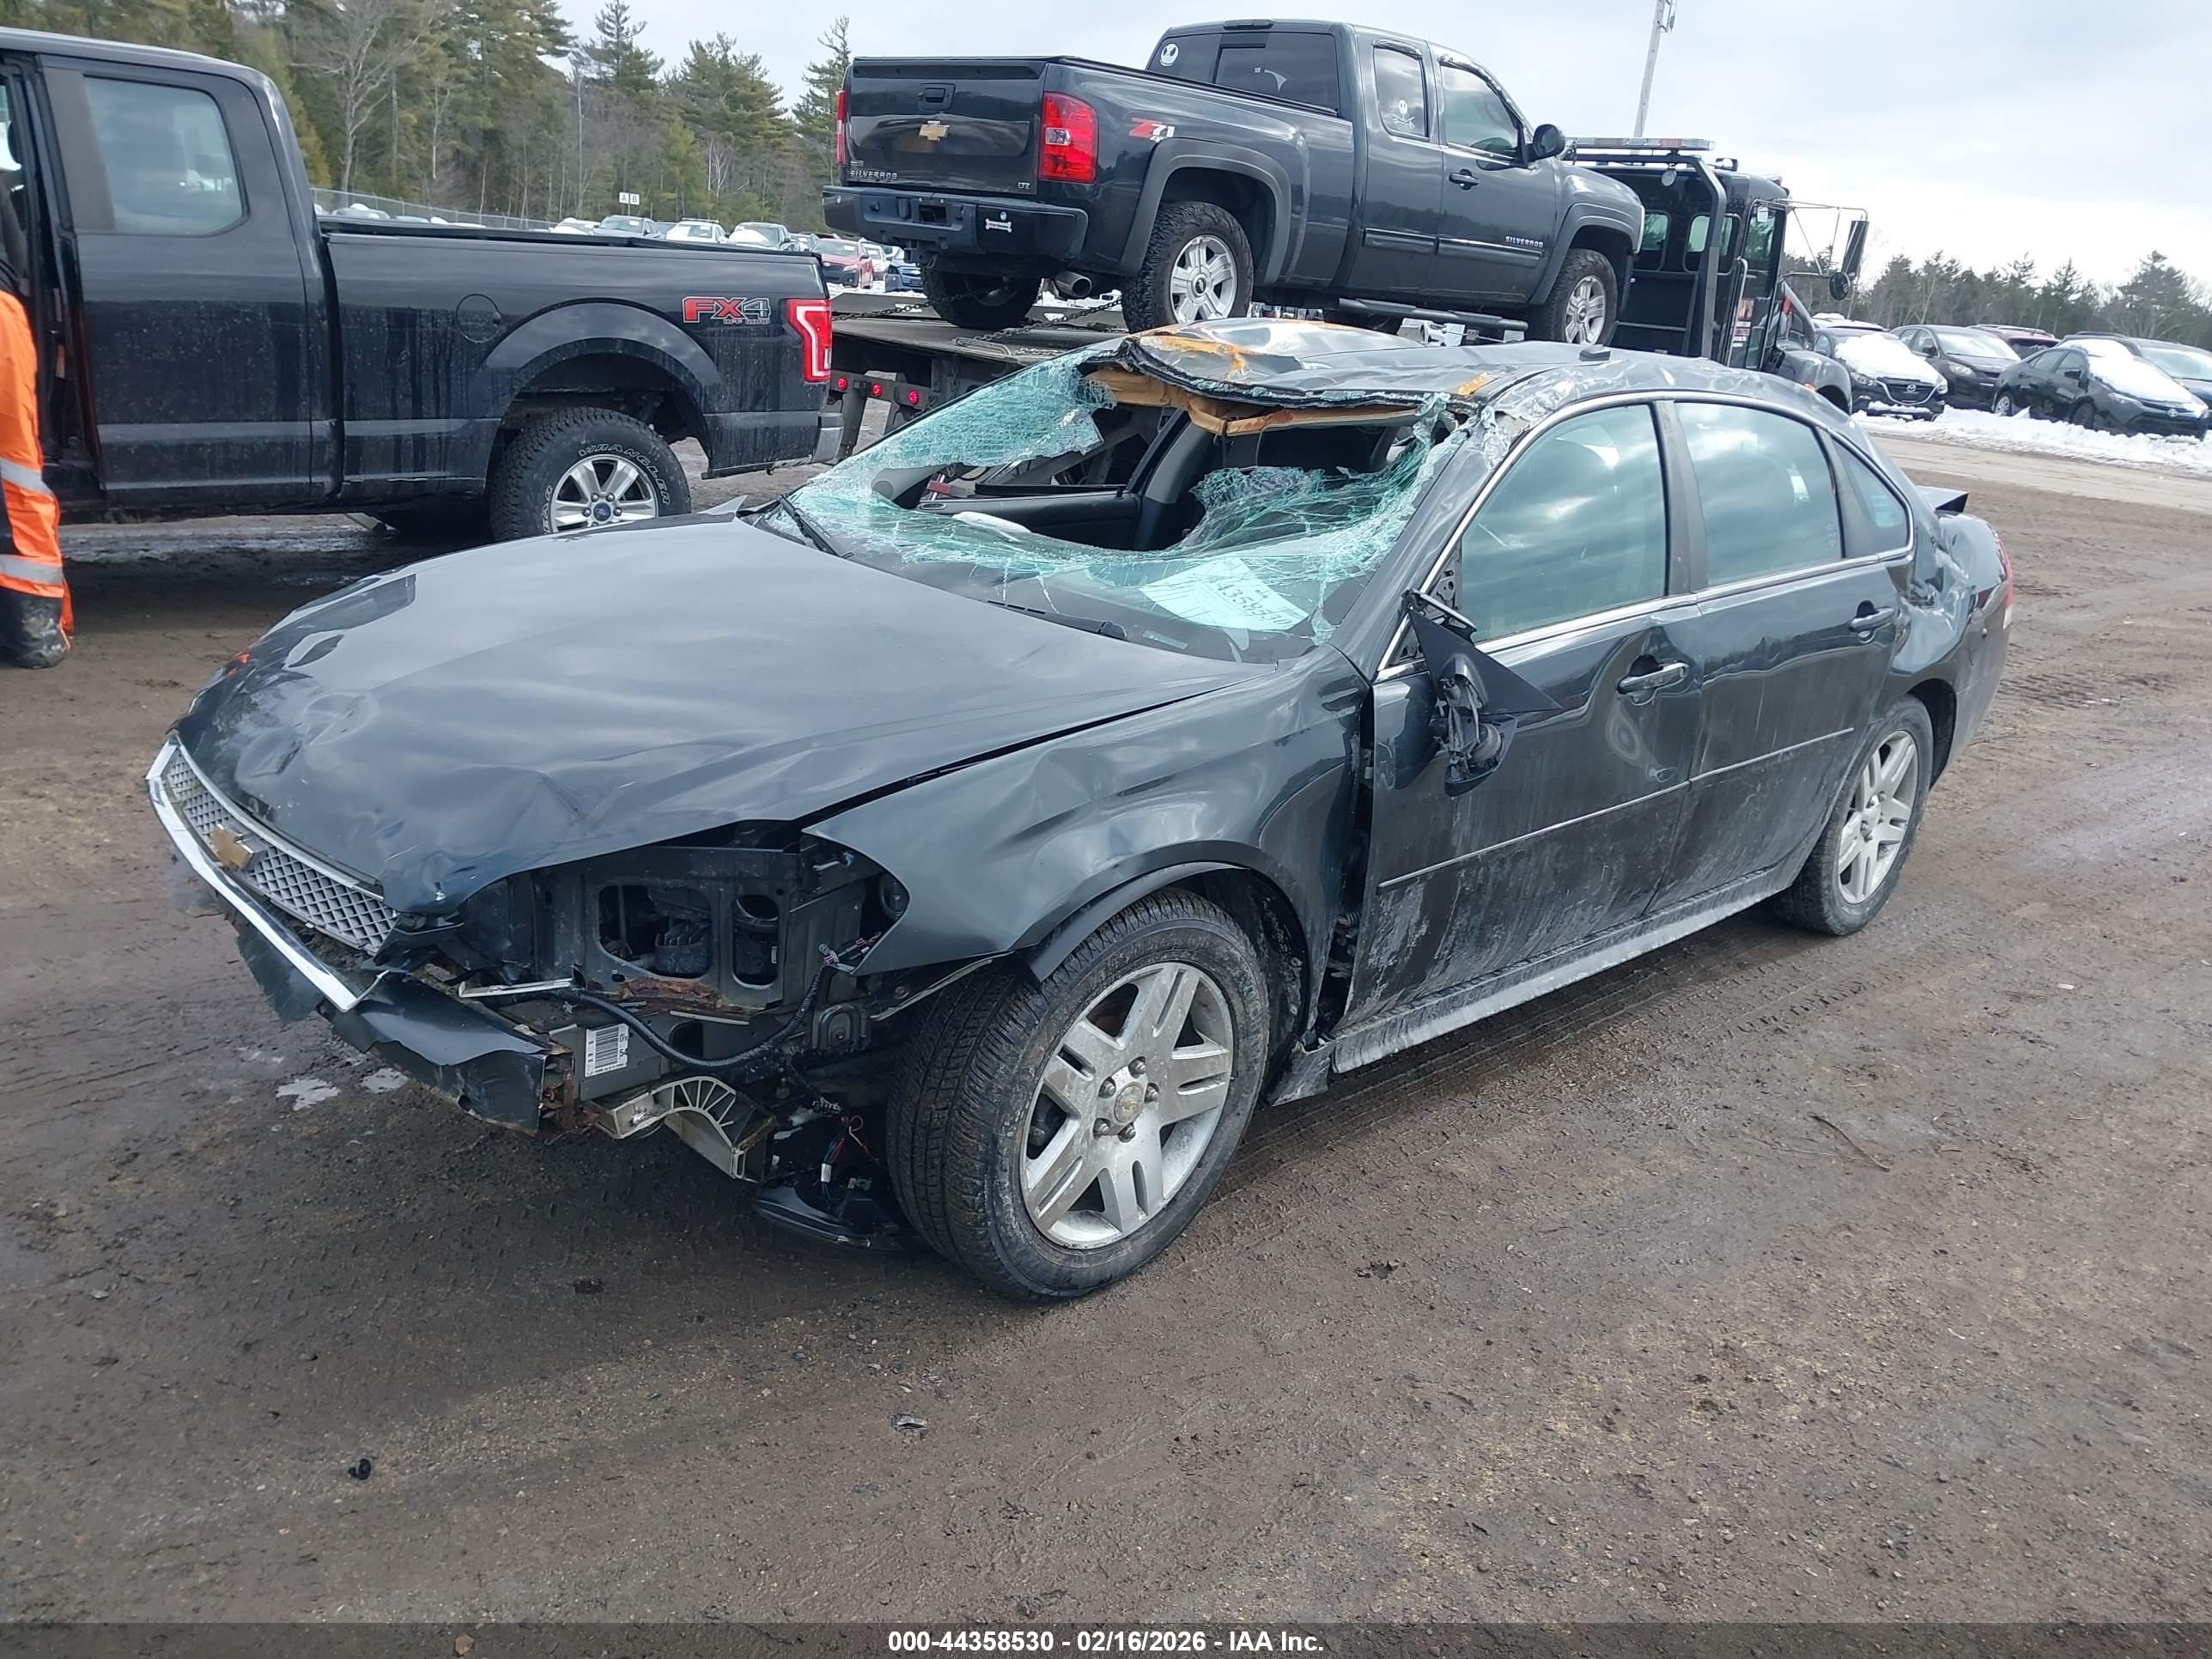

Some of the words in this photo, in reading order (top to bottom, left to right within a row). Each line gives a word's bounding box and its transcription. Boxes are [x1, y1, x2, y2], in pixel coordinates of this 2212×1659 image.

[1128, 117, 1176, 138] Z71
[850, 170, 897, 179] SILVERADO
[1505, 235, 1544, 248] SILVERADO
[683, 296, 771, 323] FX4
[579, 443, 671, 507] WRANGLER
